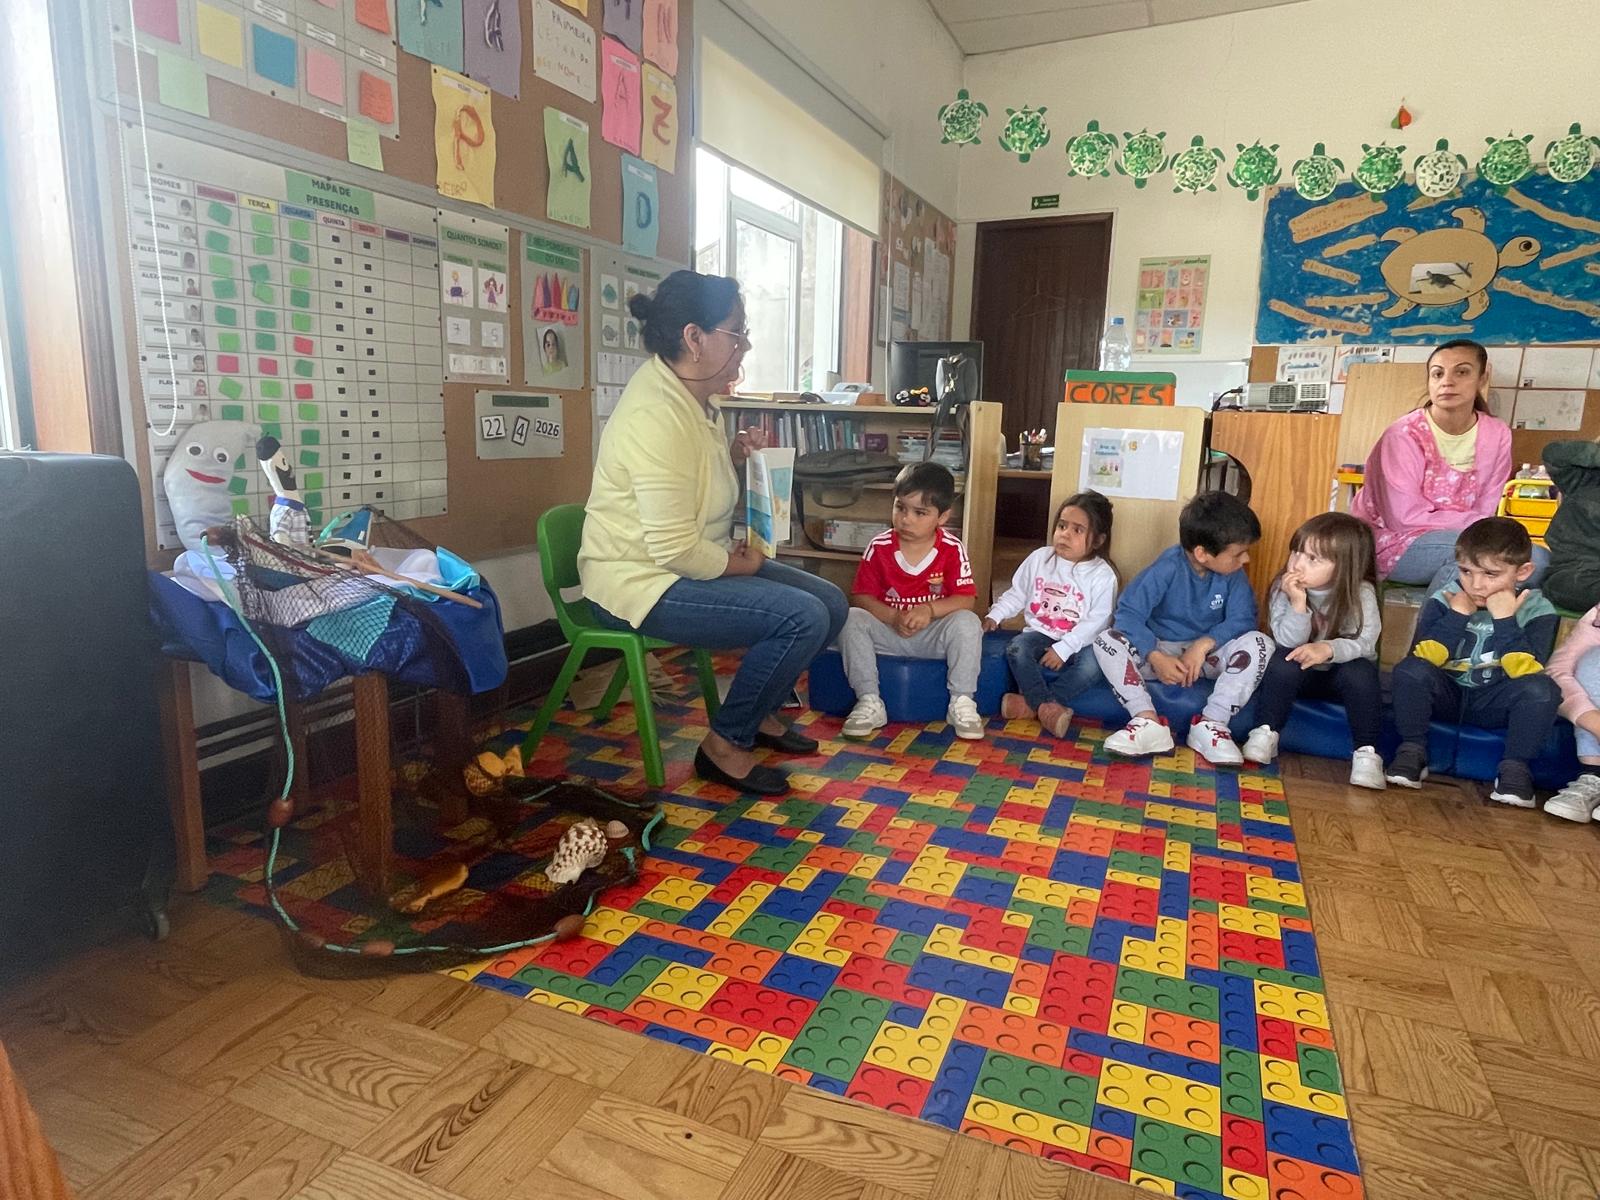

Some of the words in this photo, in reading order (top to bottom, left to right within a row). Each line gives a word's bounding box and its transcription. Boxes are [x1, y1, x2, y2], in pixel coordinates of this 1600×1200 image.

[452, 104, 485, 172] P
[562, 137, 585, 183] A
[150, 176, 182, 191] NOMES
[311, 178, 338, 195] MAPA
[338, 185, 351, 198] DE
[247, 198, 272, 211] TERÇA
[306, 194, 360, 216] PRESENÇAS
[322, 215, 346, 228] QUINTA
[446, 230, 477, 245] QUANTOS
[1070, 382, 1167, 405] CORES
[484, 417, 503, 437] 22
[516, 422, 526, 440] 4
[535, 420, 560, 437] 2026
